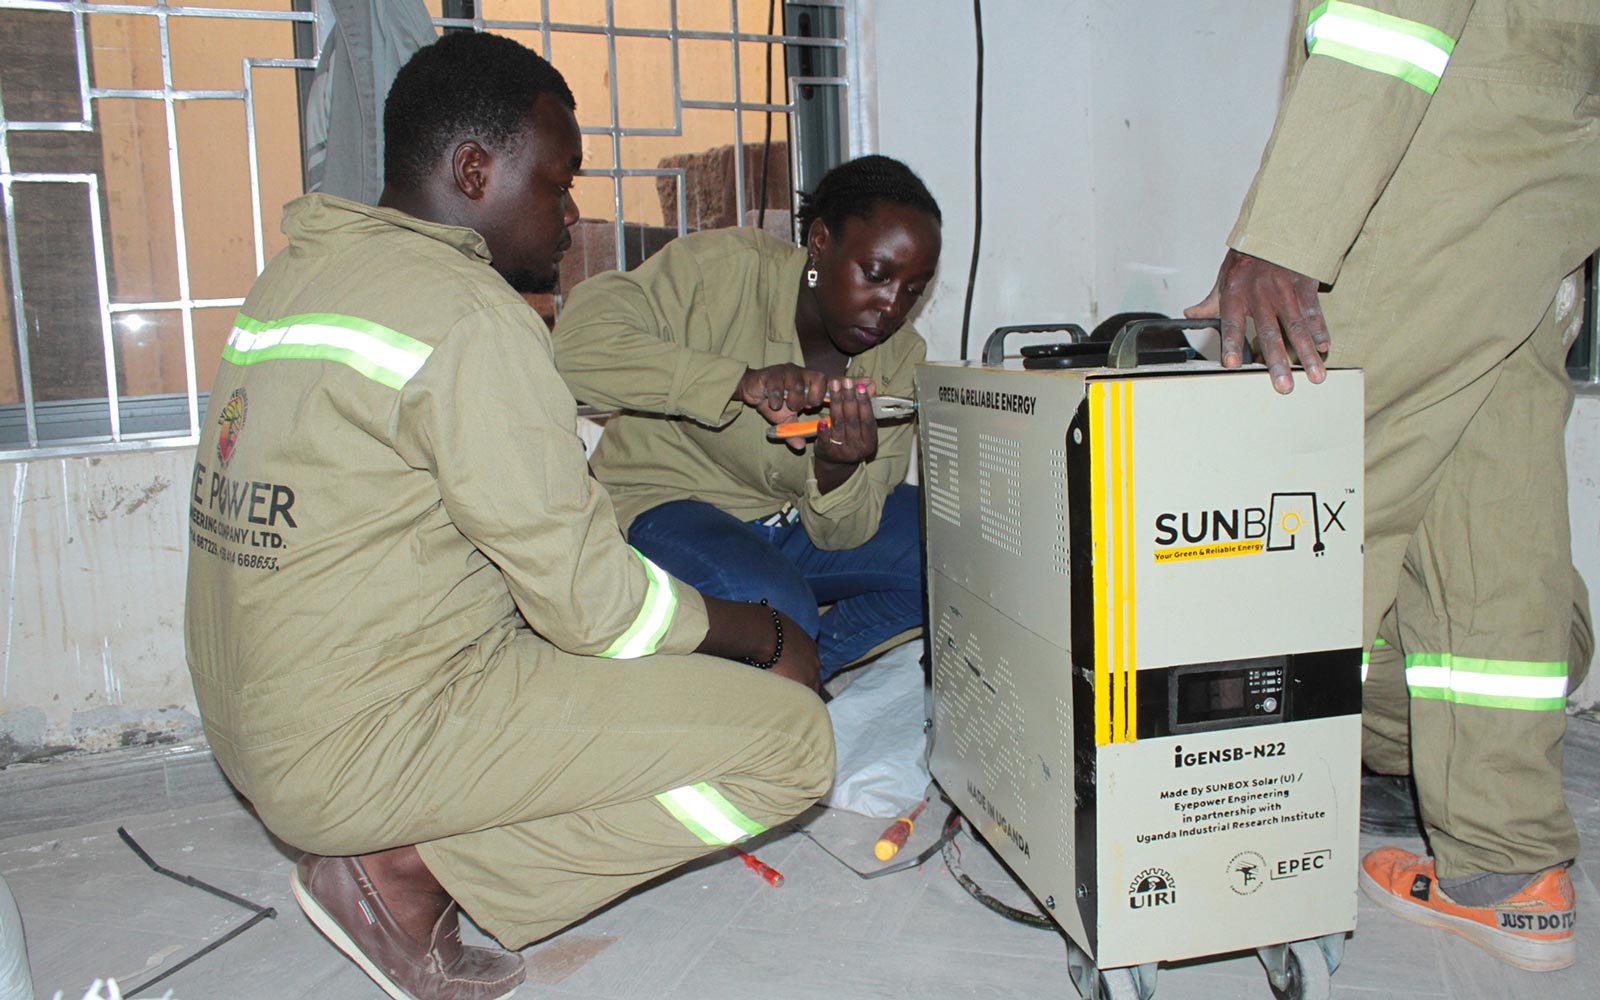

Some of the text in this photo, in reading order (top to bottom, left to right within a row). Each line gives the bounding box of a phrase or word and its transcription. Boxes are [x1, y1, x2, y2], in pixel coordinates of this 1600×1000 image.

[939, 386, 959, 403] GREEN
[966, 389, 1000, 409] RELIABLE
[1001, 392, 1036, 415] ENERGY
[209, 471, 297, 528] POWER
[251, 530, 287, 549] LTD.
[1155, 542, 1265, 561] Your Green & Reliable Energy
[1174, 742, 1286, 768] iGENSB-N22
[1160, 788, 1189, 800] Made
[1190, 786, 1204, 796] By
[1205, 780, 1250, 793] SUNBOX
[1252, 776, 1279, 787] Solar
[1280, 773, 1296, 784] (U)
[1174, 788, 1290, 812] Eyepower Engineering
[967, 778, 1031, 860] MADE IN UGANDA
[1182, 802, 1282, 823] in partnership with
[1136, 810, 1326, 844] Uganda Industrial Research Institute
[1277, 855, 1324, 875] EPEC
[1130, 890, 1176, 909] UIRI
[1501, 913, 1534, 930] JUST
[1537, 914, 1560, 930] DO
